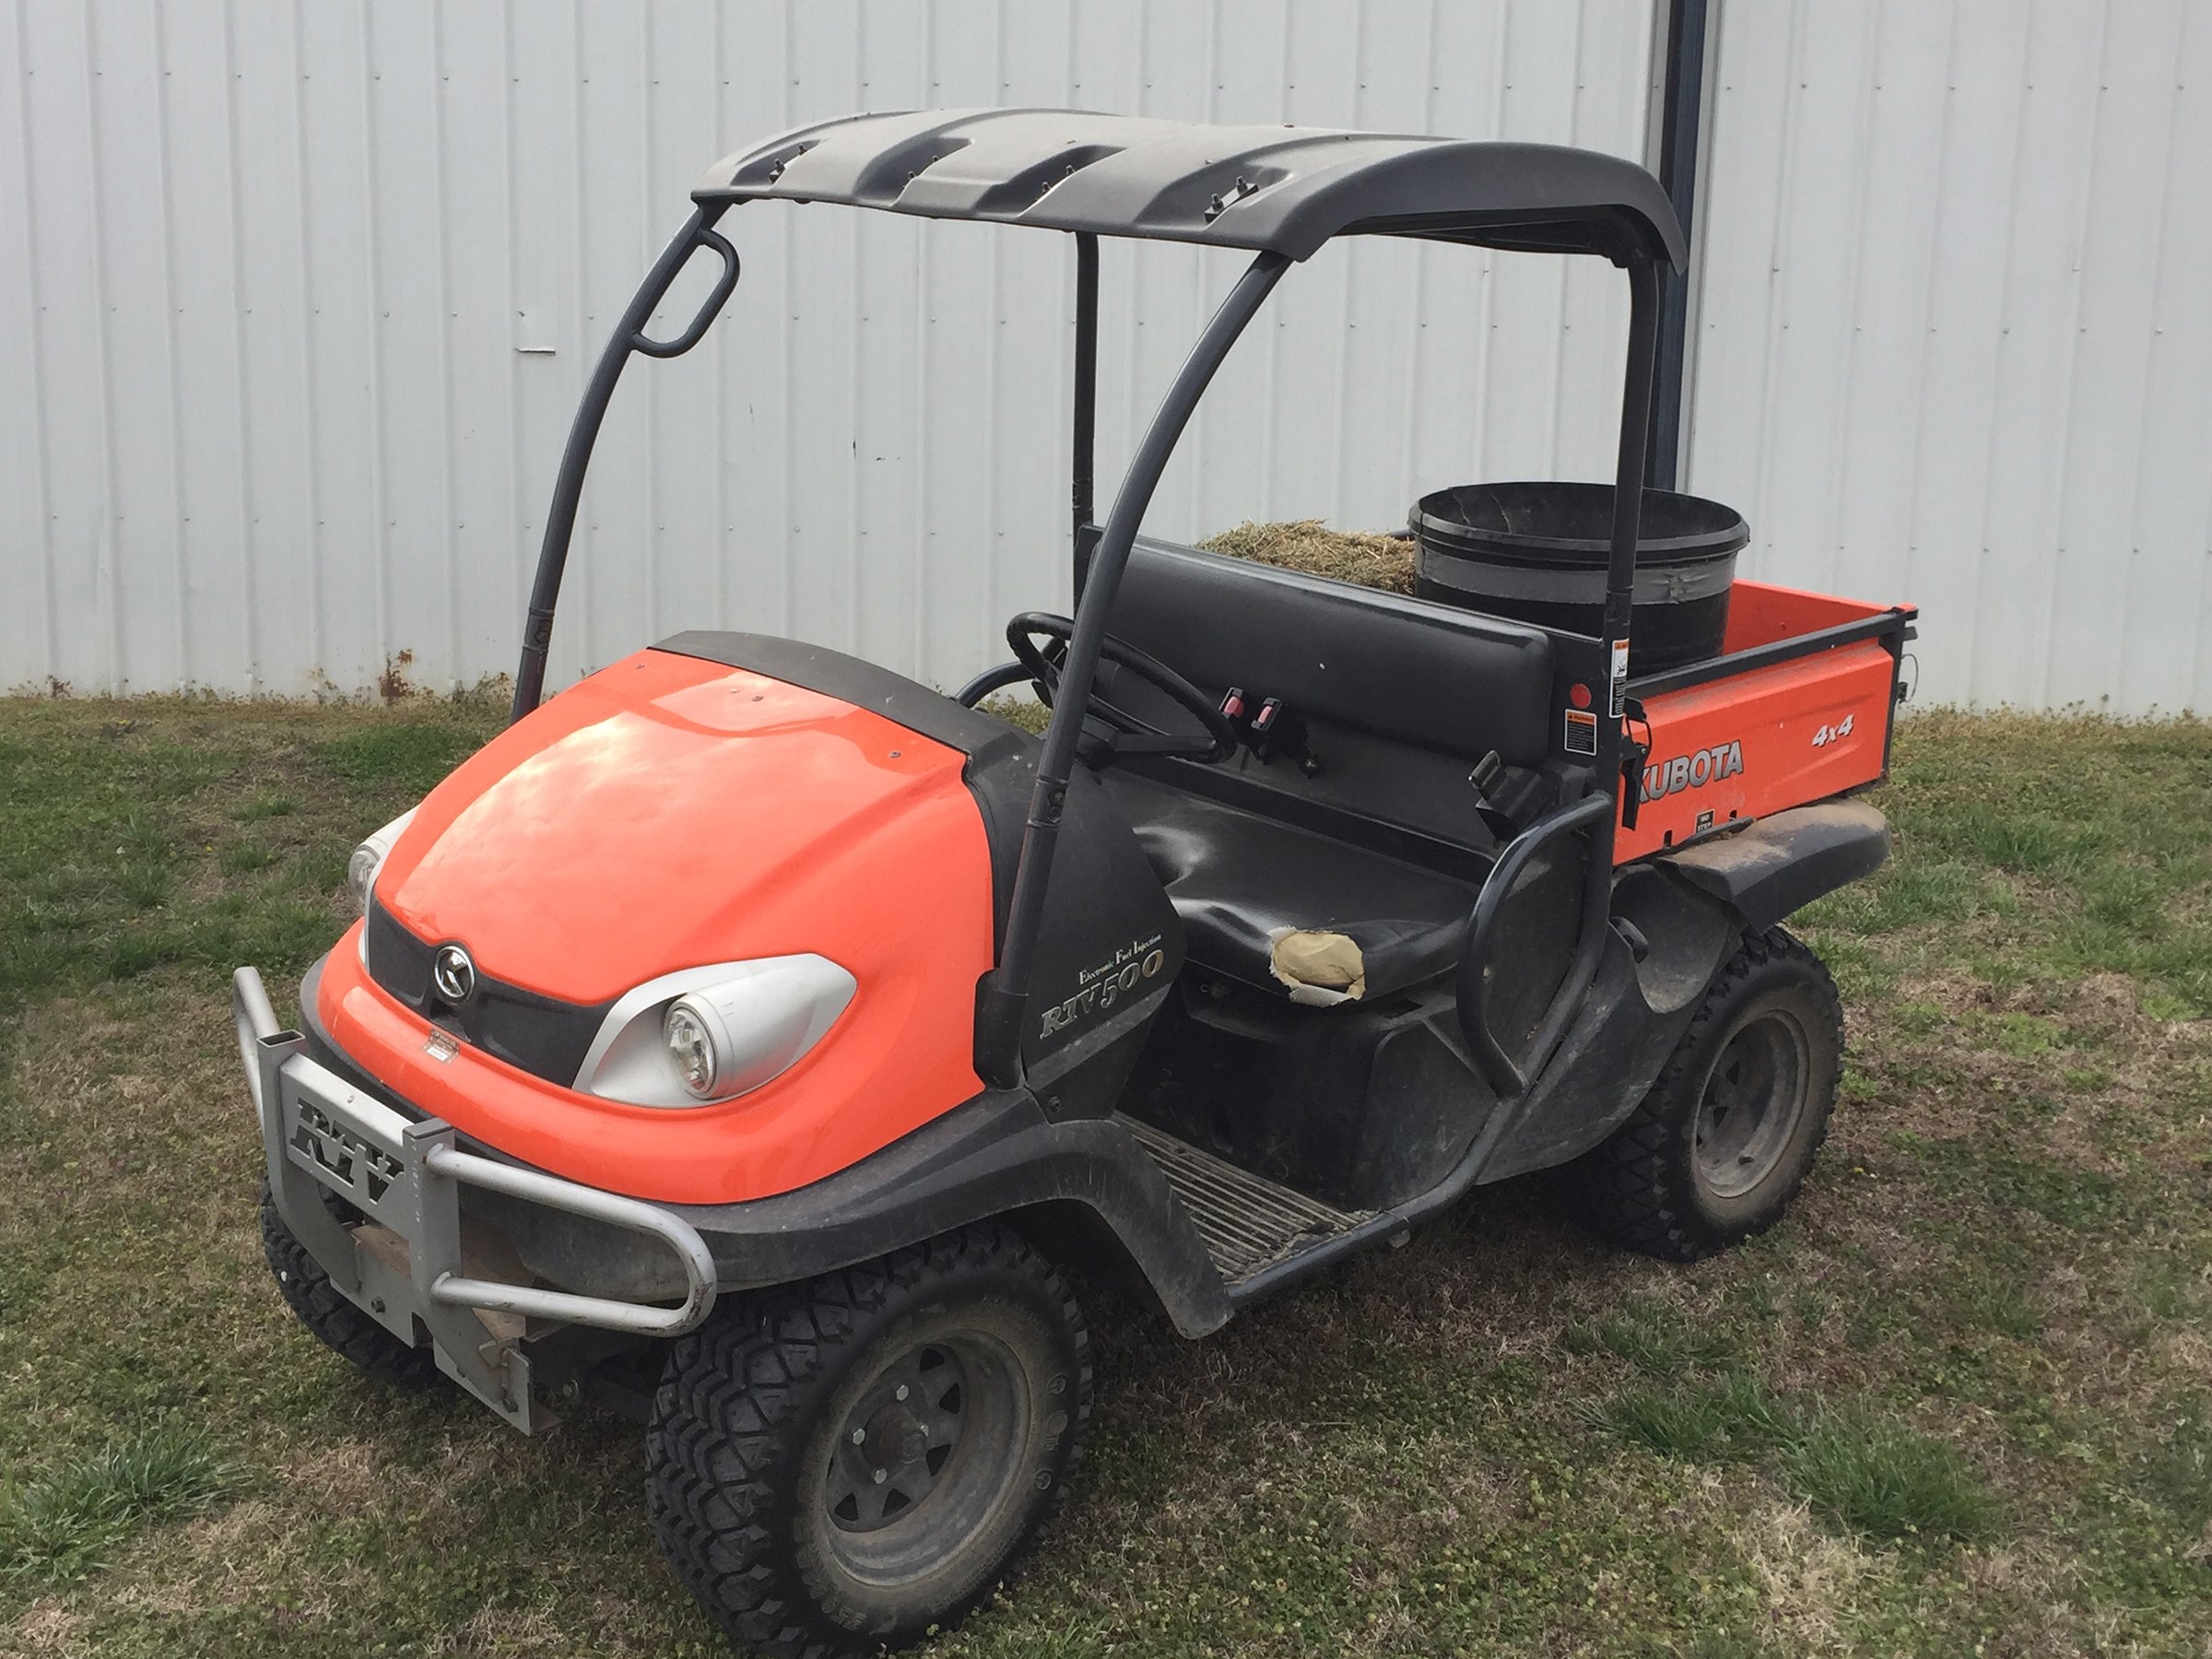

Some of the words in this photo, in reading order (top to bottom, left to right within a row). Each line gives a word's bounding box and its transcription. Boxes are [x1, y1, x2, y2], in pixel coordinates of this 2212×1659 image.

[1812, 714, 1854, 747] 4x4
[1115, 949, 1133, 965] Fuel
[1040, 949, 1164, 1040] RTV500
[289, 1097, 405, 1206] RTV
